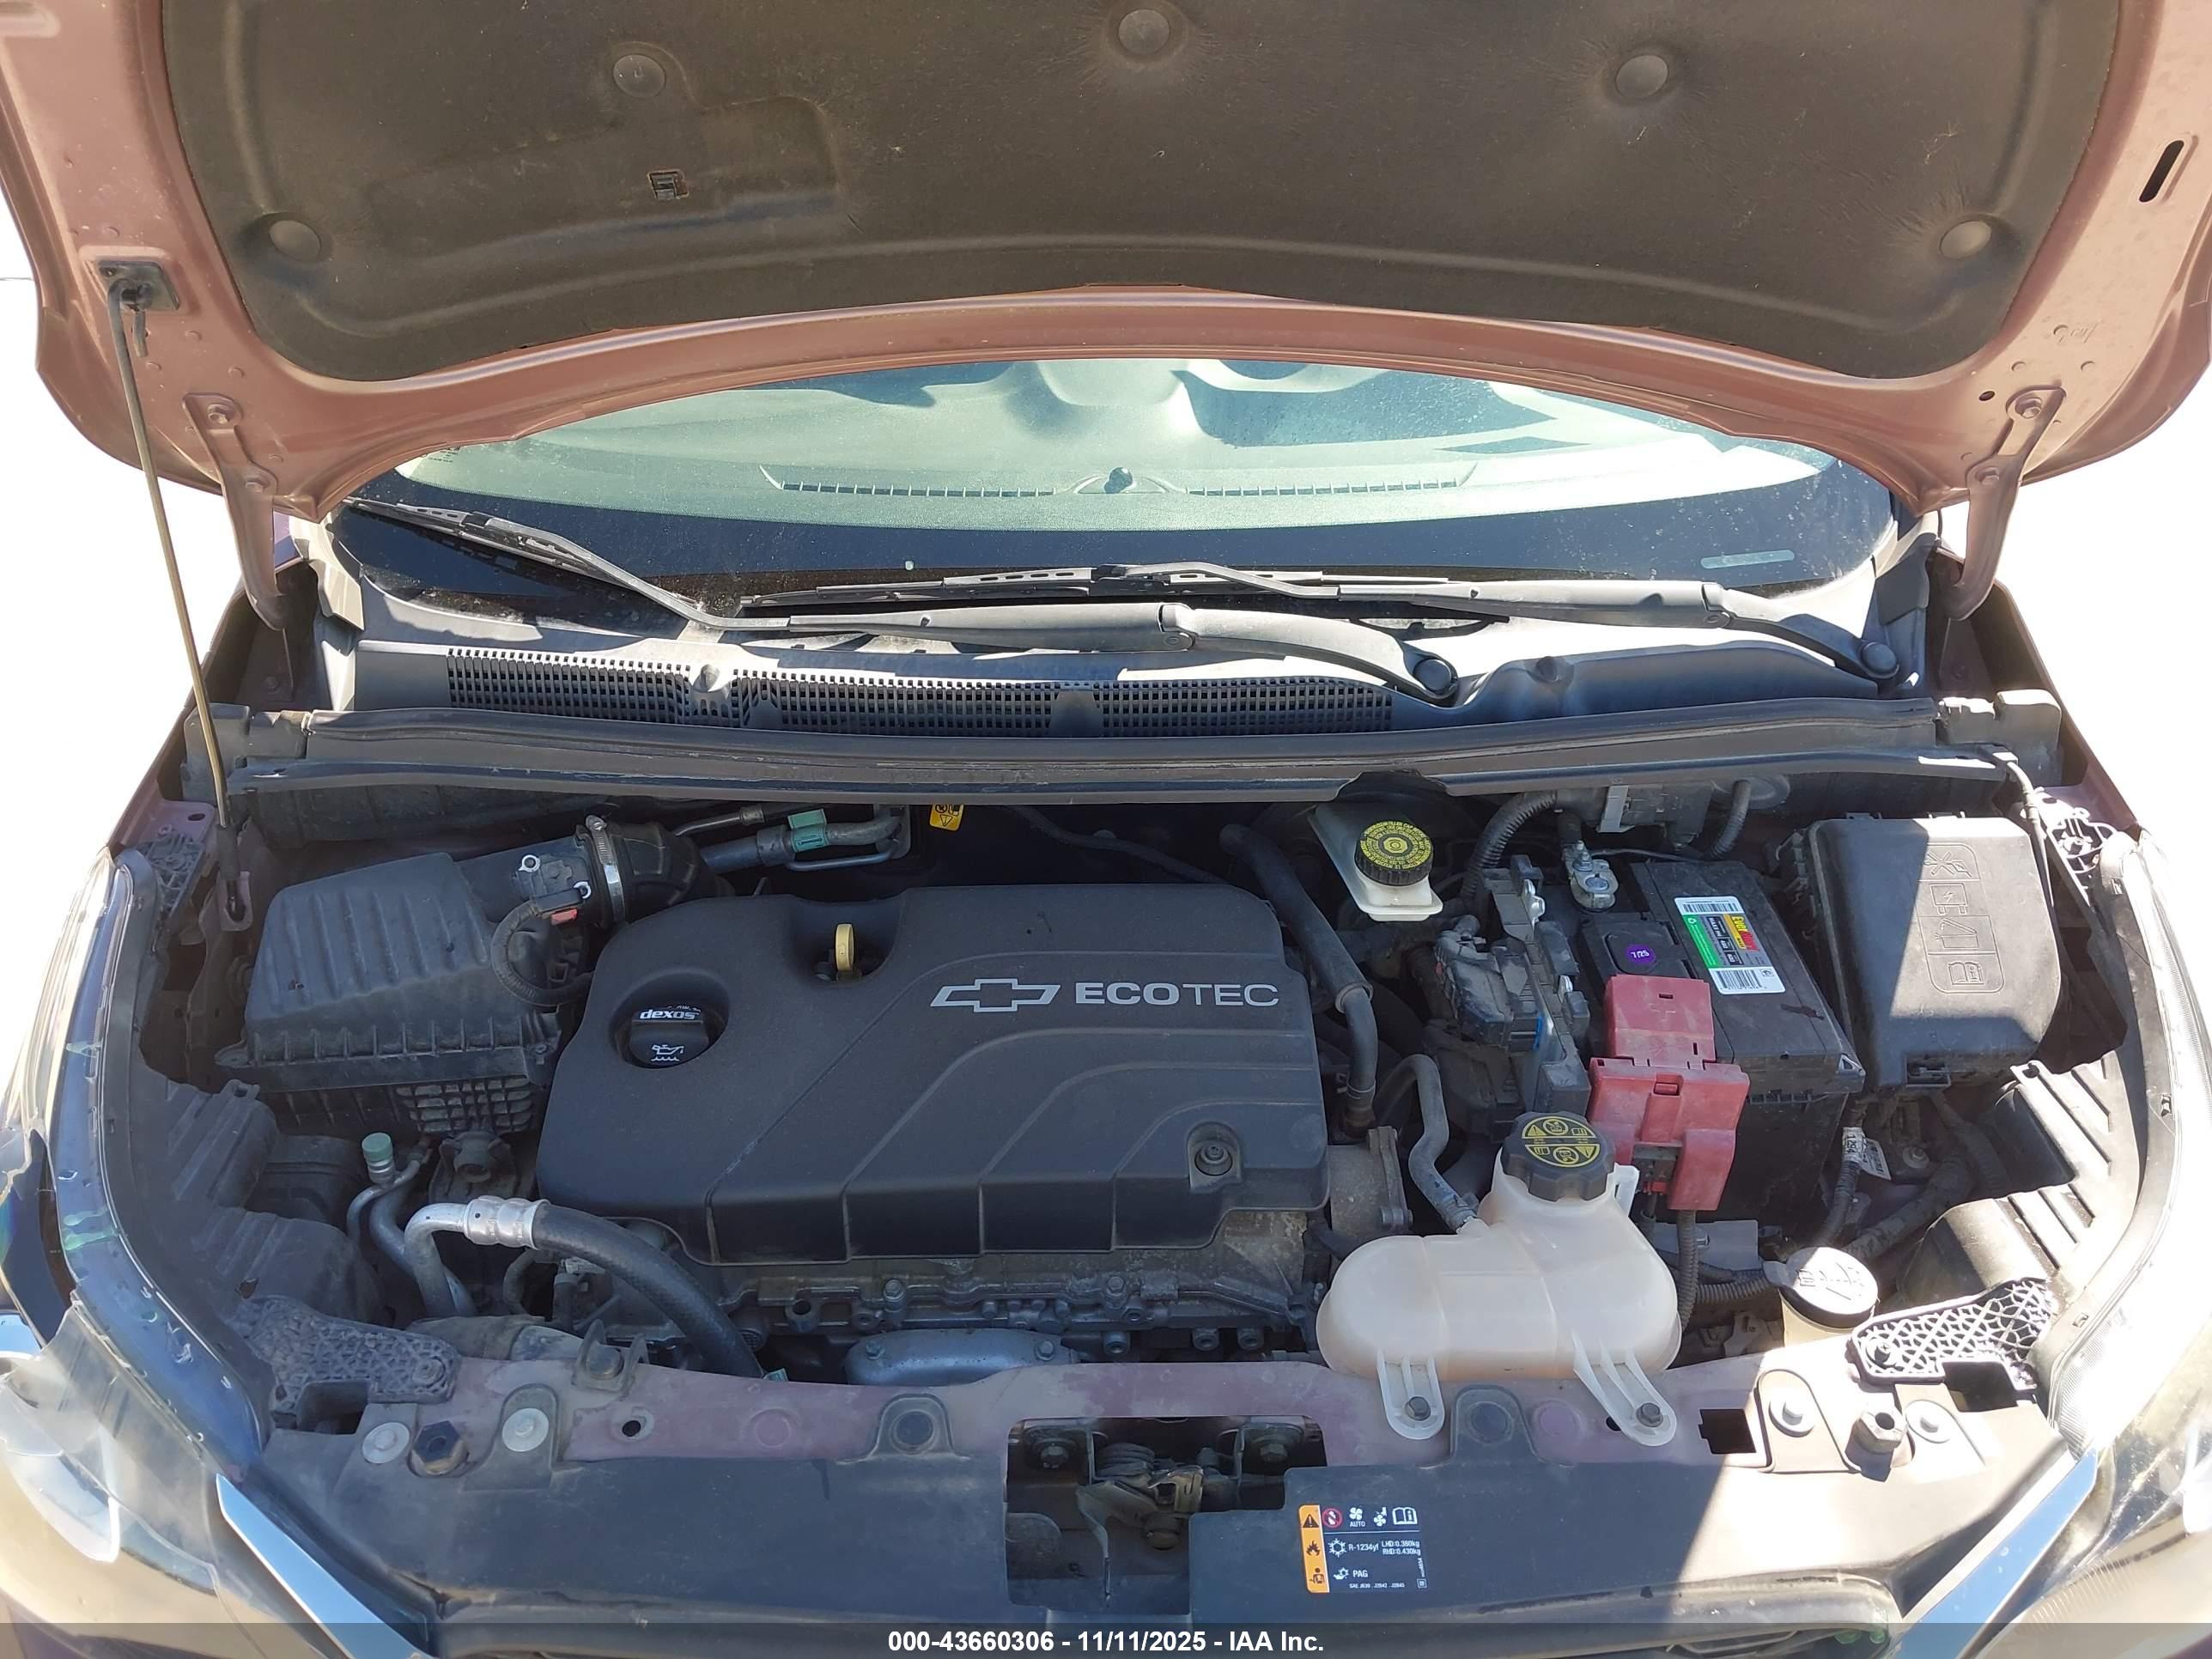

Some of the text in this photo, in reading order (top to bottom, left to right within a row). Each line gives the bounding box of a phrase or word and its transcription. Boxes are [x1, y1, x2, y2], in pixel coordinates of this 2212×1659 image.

[1075, 981, 1279, 1006] ECOTEC
[639, 1009, 699, 1020] dexos
[1348, 1543, 1379, 1553] R-1234yf
[1352, 1570, 1369, 1578] PAG
